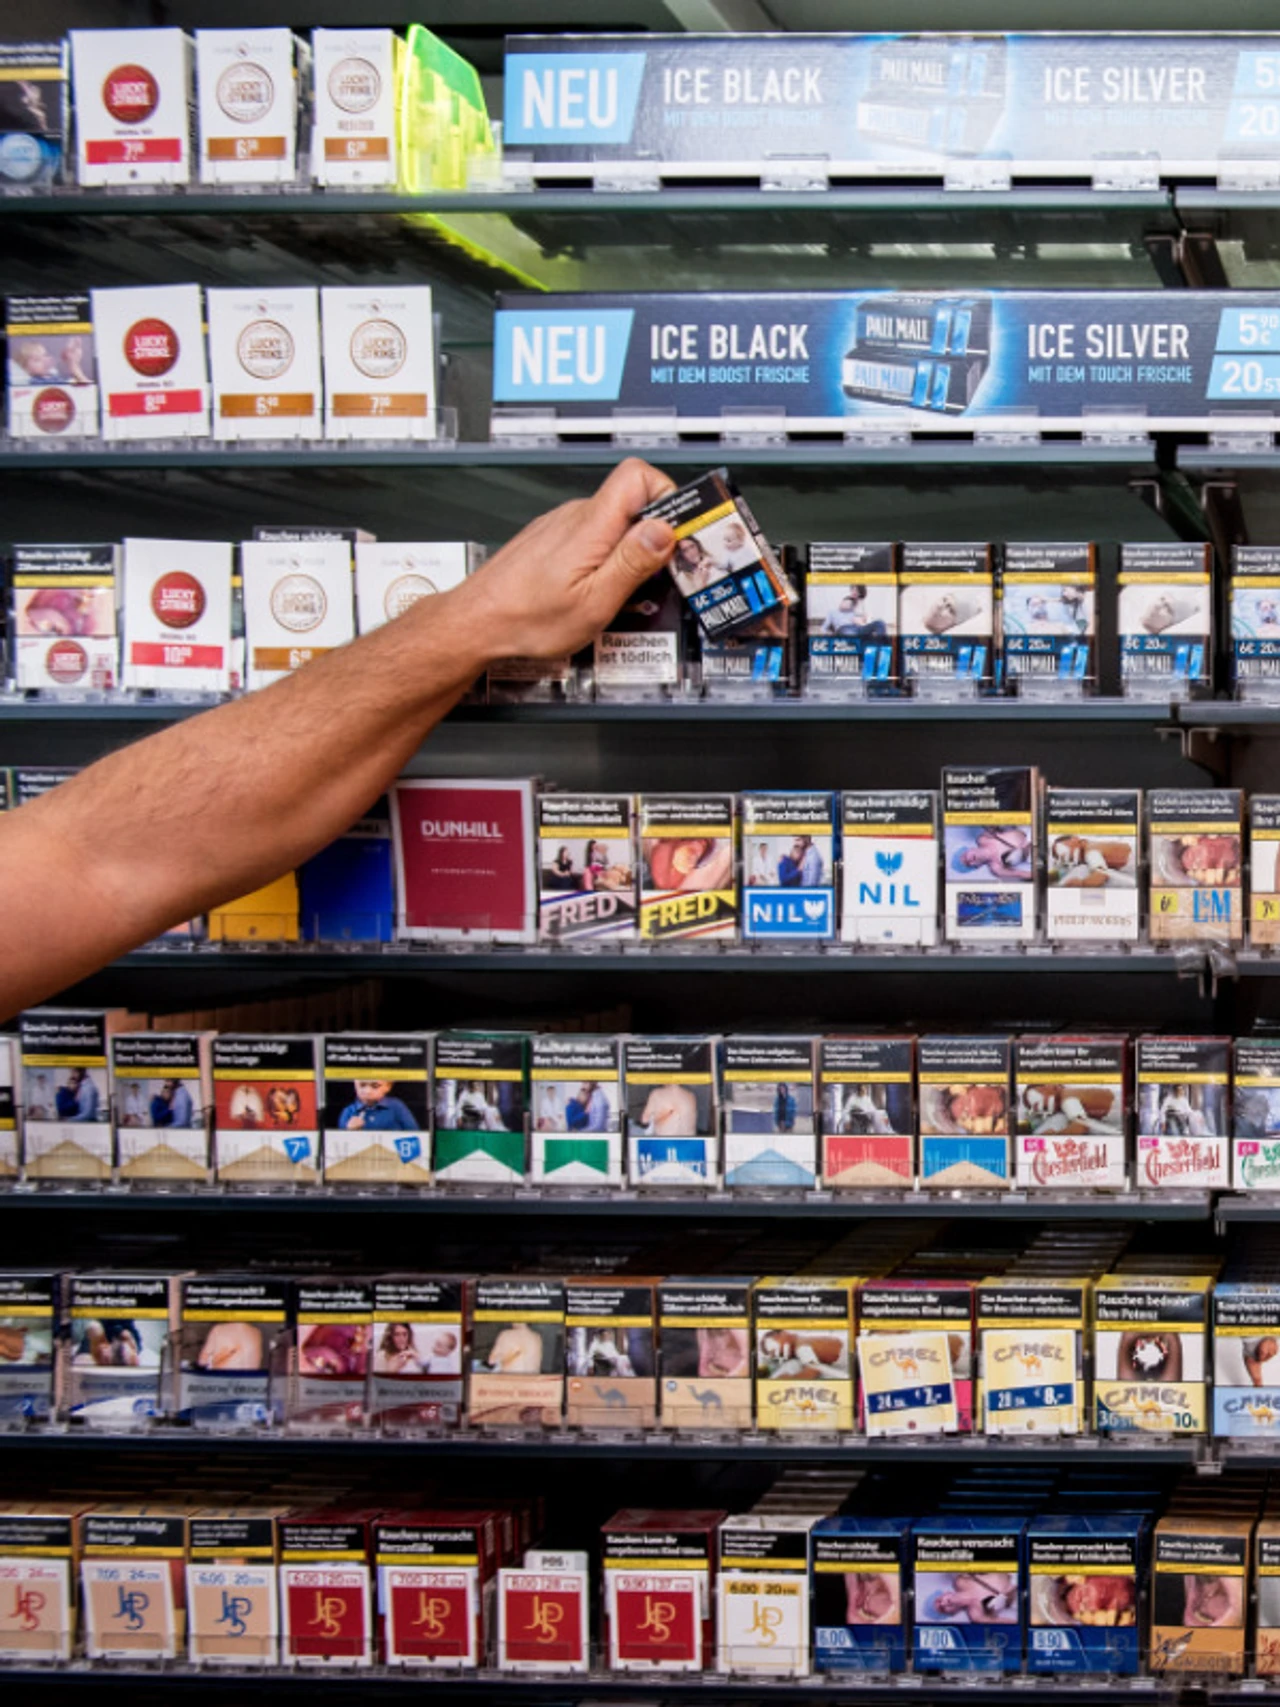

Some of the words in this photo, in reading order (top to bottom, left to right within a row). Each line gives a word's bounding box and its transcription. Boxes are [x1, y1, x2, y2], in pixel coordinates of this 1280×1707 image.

[522, 68, 618, 130] NEU
[664, 67, 709, 104] ICE
[723, 67, 823, 104] BLACK
[1044, 67, 1090, 103] ICE
[1102, 66, 1206, 103] SILVER
[650, 324, 698, 360] ICE
[710, 324, 810, 360] BLACK
[865, 315, 896, 341] PALL
[897, 319, 930, 343] MALL
[1028, 324, 1074, 359] ICE
[1085, 324, 1190, 359] SILVER
[511, 325, 606, 385] NEU
[650, 366, 676, 383] MIT
[679, 366, 706, 383] DEM
[709, 366, 751, 383] BOOST
[754, 366, 810, 383] FRISCHE
[1028, 366, 1053, 383] MIT
[1057, 366, 1085, 383] DEM
[1089, 366, 1133, 383] TOUCH
[1136, 366, 1193, 383] FRISCHE
[700, 603, 727, 629] PALL
[722, 595, 749, 620] MALL
[601, 634, 669, 649] Rauchen
[598, 650, 619, 666] ist
[621, 650, 673, 667] tödlich
[421, 820, 504, 838] DUNHILL
[859, 883, 920, 907] NIL
[1193, 889, 1232, 924] L&M
[541, 892, 618, 937] FRED
[642, 892, 719, 936] FRED
[752, 903, 801, 923] NIL
[1032, 1143, 1109, 1186] Chesterfield
[1144, 1143, 1221, 1186] Chesterfield
[869, 1346, 941, 1366] CAMEL
[993, 1345, 1066, 1363] CAMEL
[767, 1386, 841, 1406] CAMEL
[1104, 1386, 1190, 1409] CAMEL
